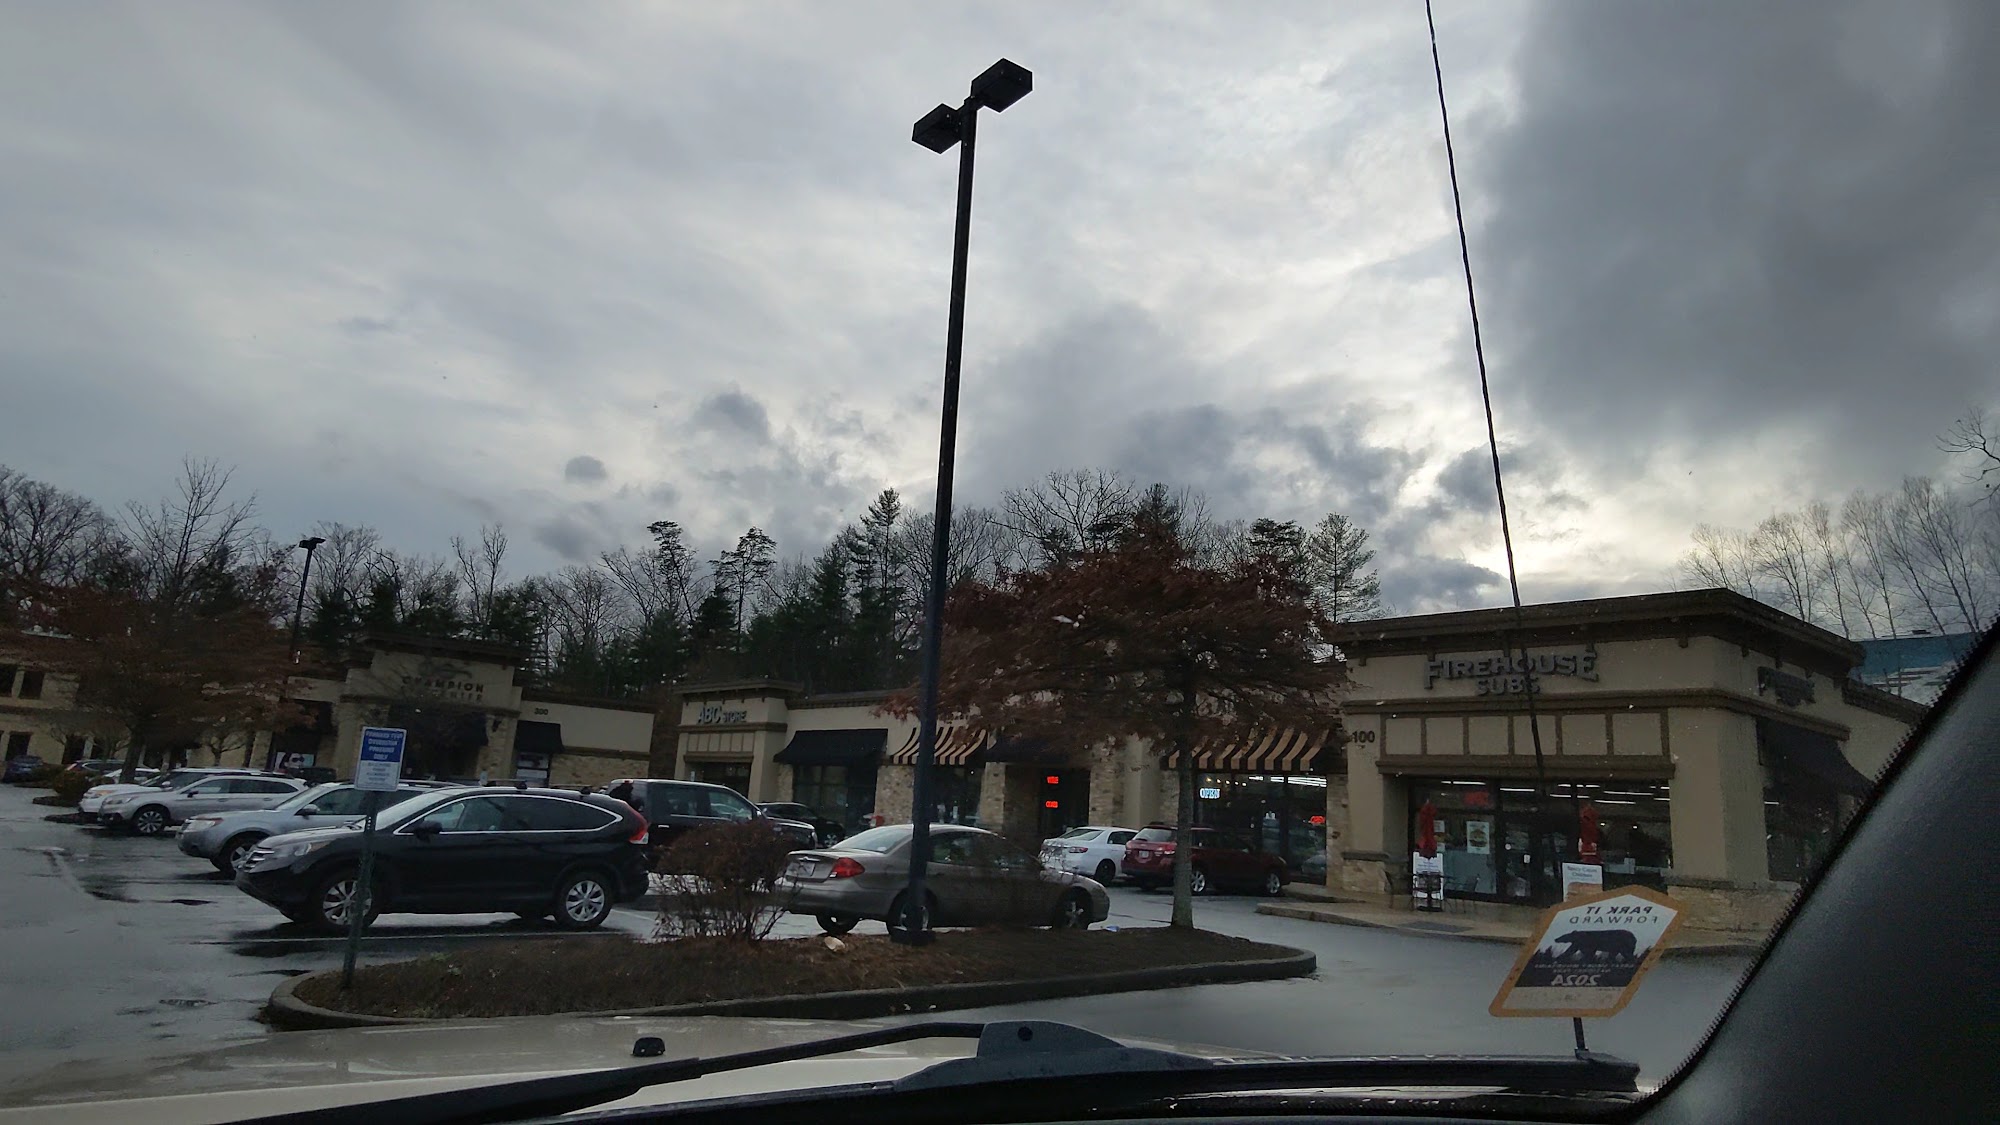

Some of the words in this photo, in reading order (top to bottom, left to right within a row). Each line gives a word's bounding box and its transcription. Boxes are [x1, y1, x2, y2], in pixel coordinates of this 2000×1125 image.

[1424, 652, 1598, 690] FIREHOUSE
[1477, 675, 1541, 697] SUBS
[698, 705, 723, 724] ABC
[1352, 730, 1376, 743] 100
[1199, 788, 1221, 799] OPEN
